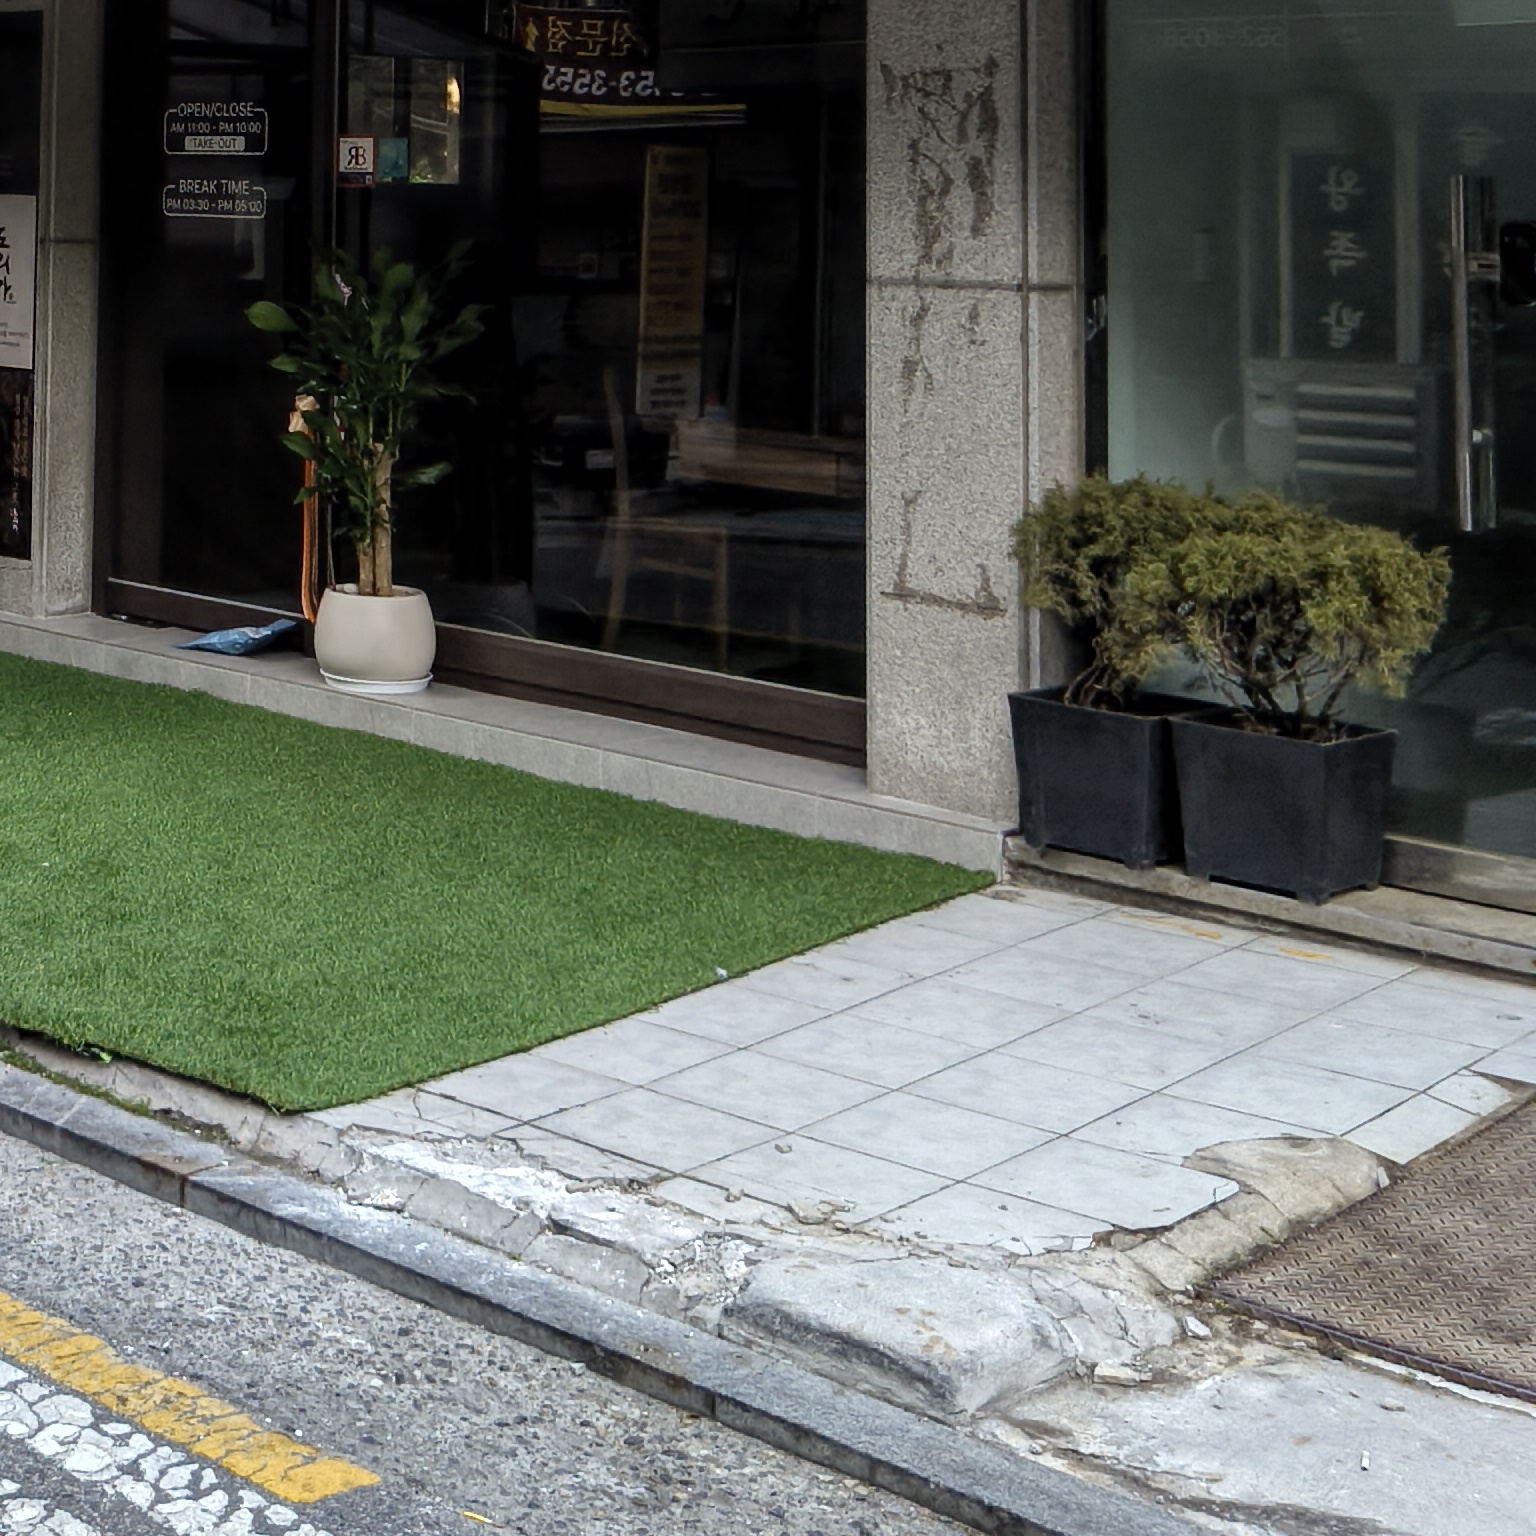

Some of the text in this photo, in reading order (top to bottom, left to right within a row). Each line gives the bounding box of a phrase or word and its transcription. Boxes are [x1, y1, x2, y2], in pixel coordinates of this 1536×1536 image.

[177, 102, 255, 119] OPEN/CLOSE
[170, 122, 185, 133] AM
[187, 122, 210, 134] 11:00
[218, 122, 234, 134] PM
[236, 122, 262, 134] 10:00
[192, 138, 238, 149] TAKE-OUT
[179, 179, 250, 195] BREAK TIME
[166, 198, 181, 209] PM
[182, 199, 210, 211] 03:30
[218, 200, 233, 211] PM
[234, 200, 263, 212] 05:00
